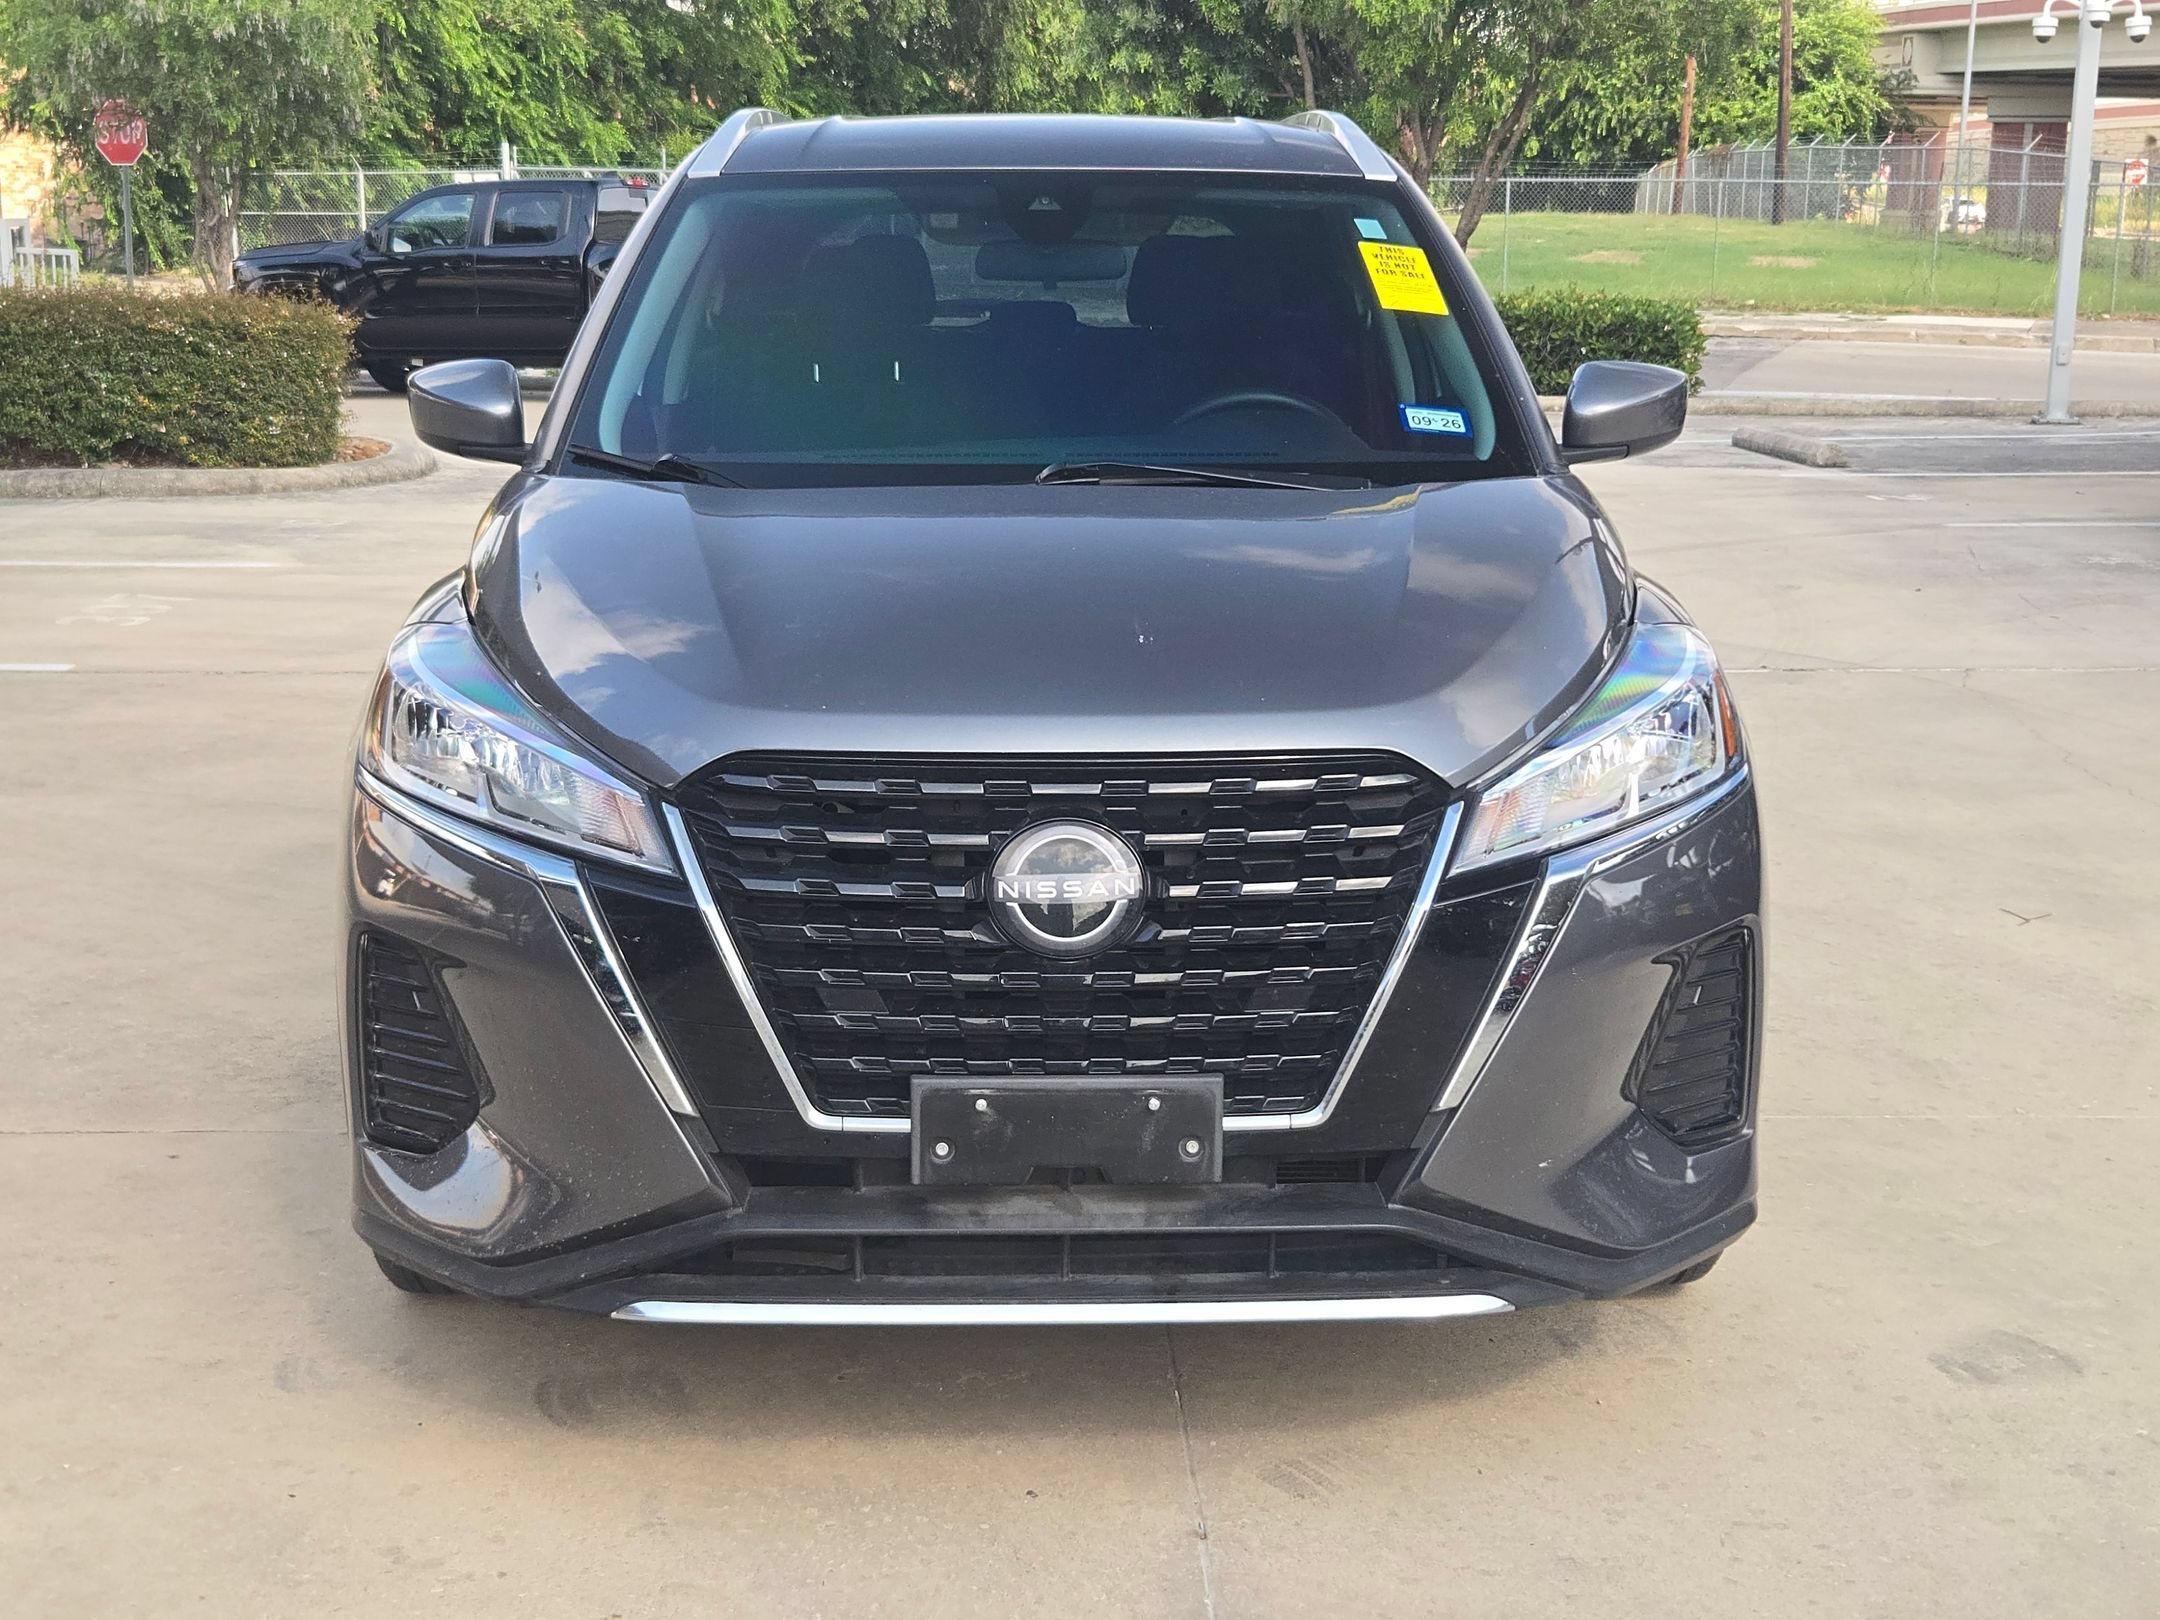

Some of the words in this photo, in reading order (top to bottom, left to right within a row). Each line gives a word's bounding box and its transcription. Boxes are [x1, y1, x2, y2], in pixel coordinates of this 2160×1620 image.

[1379, 246, 1405, 255] THIS
[1372, 253, 1416, 263] VEHICLE
[1380, 260, 1391, 268] IS
[1394, 262, 1416, 271] NOT
[1375, 268, 1397, 276] FOR
[1400, 270, 1425, 279] SALE
[997, 877, 1136, 899] NISSAN
